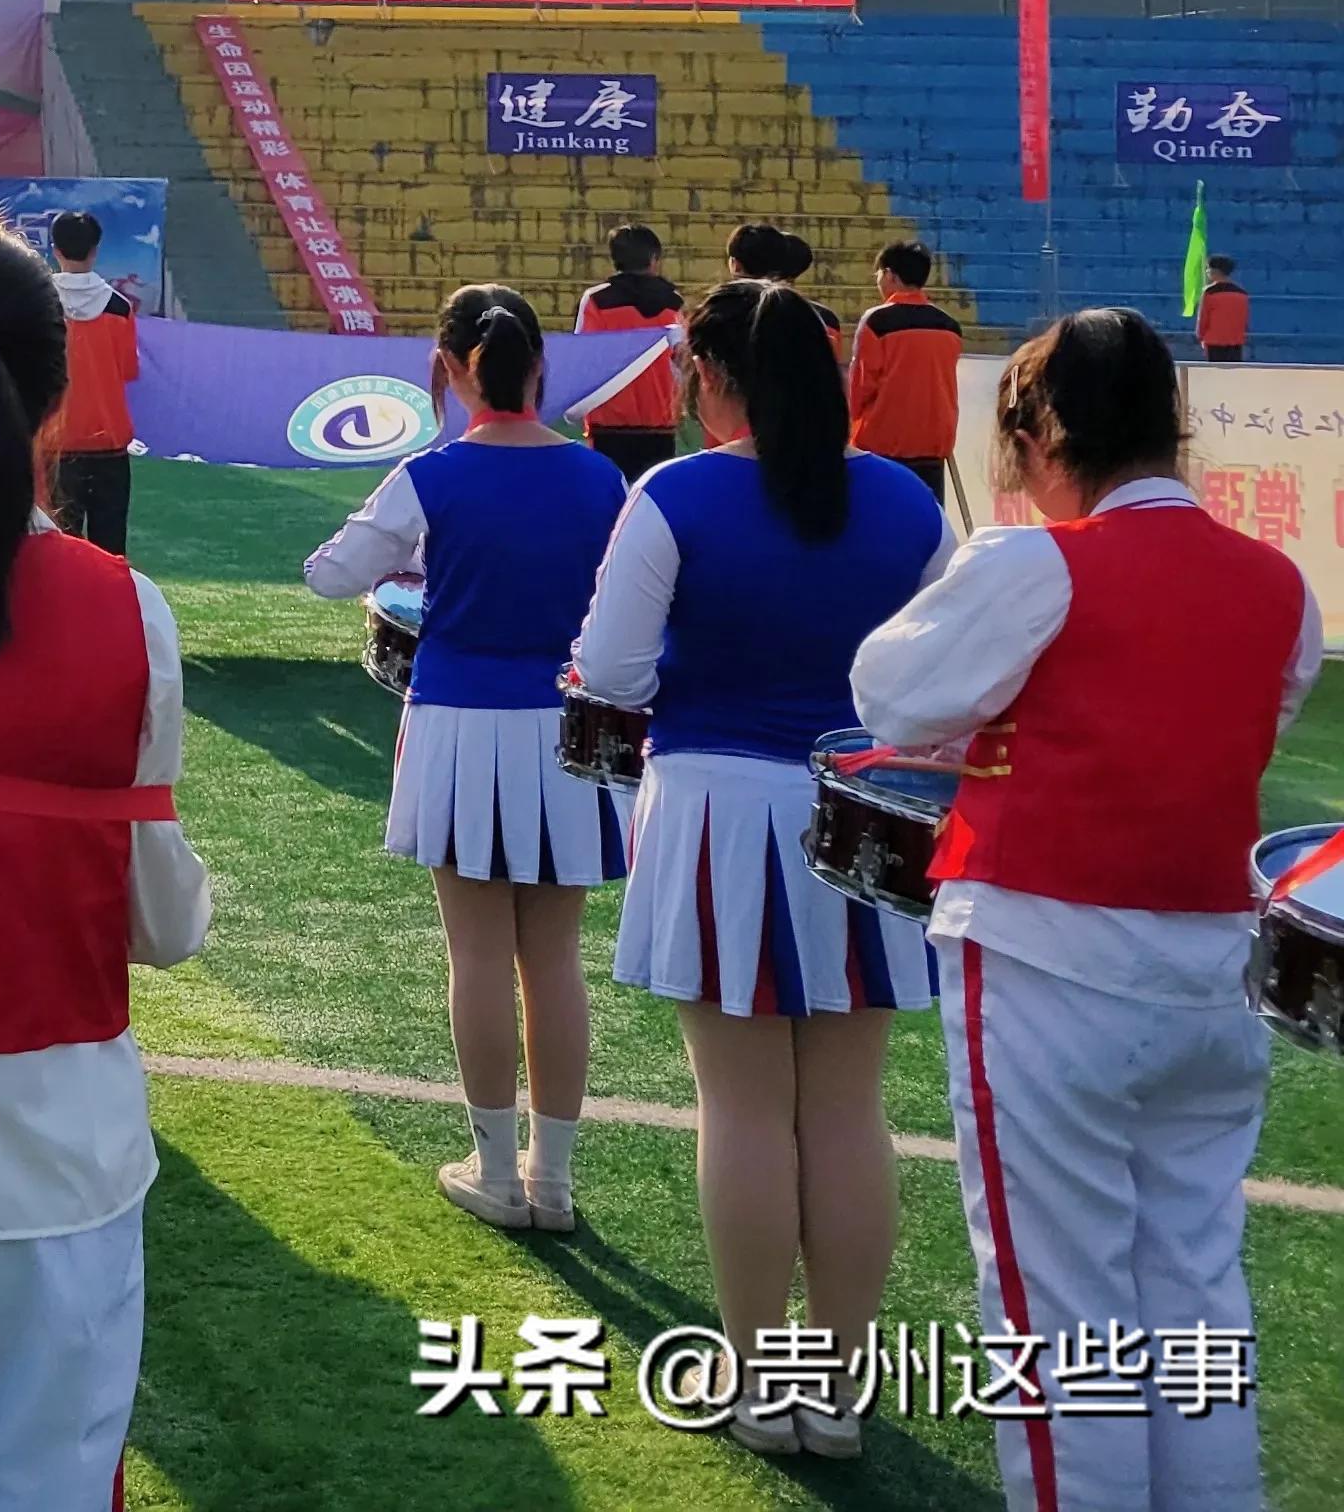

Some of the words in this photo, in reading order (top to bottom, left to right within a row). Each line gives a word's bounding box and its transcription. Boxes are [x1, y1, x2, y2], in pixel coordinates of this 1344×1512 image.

[499, 80, 648, 130] 健康
[1125, 87, 1282, 138] 勤奋
[513, 131, 630, 154] Jiankang
[1153, 139, 1254, 161] Qinfen
